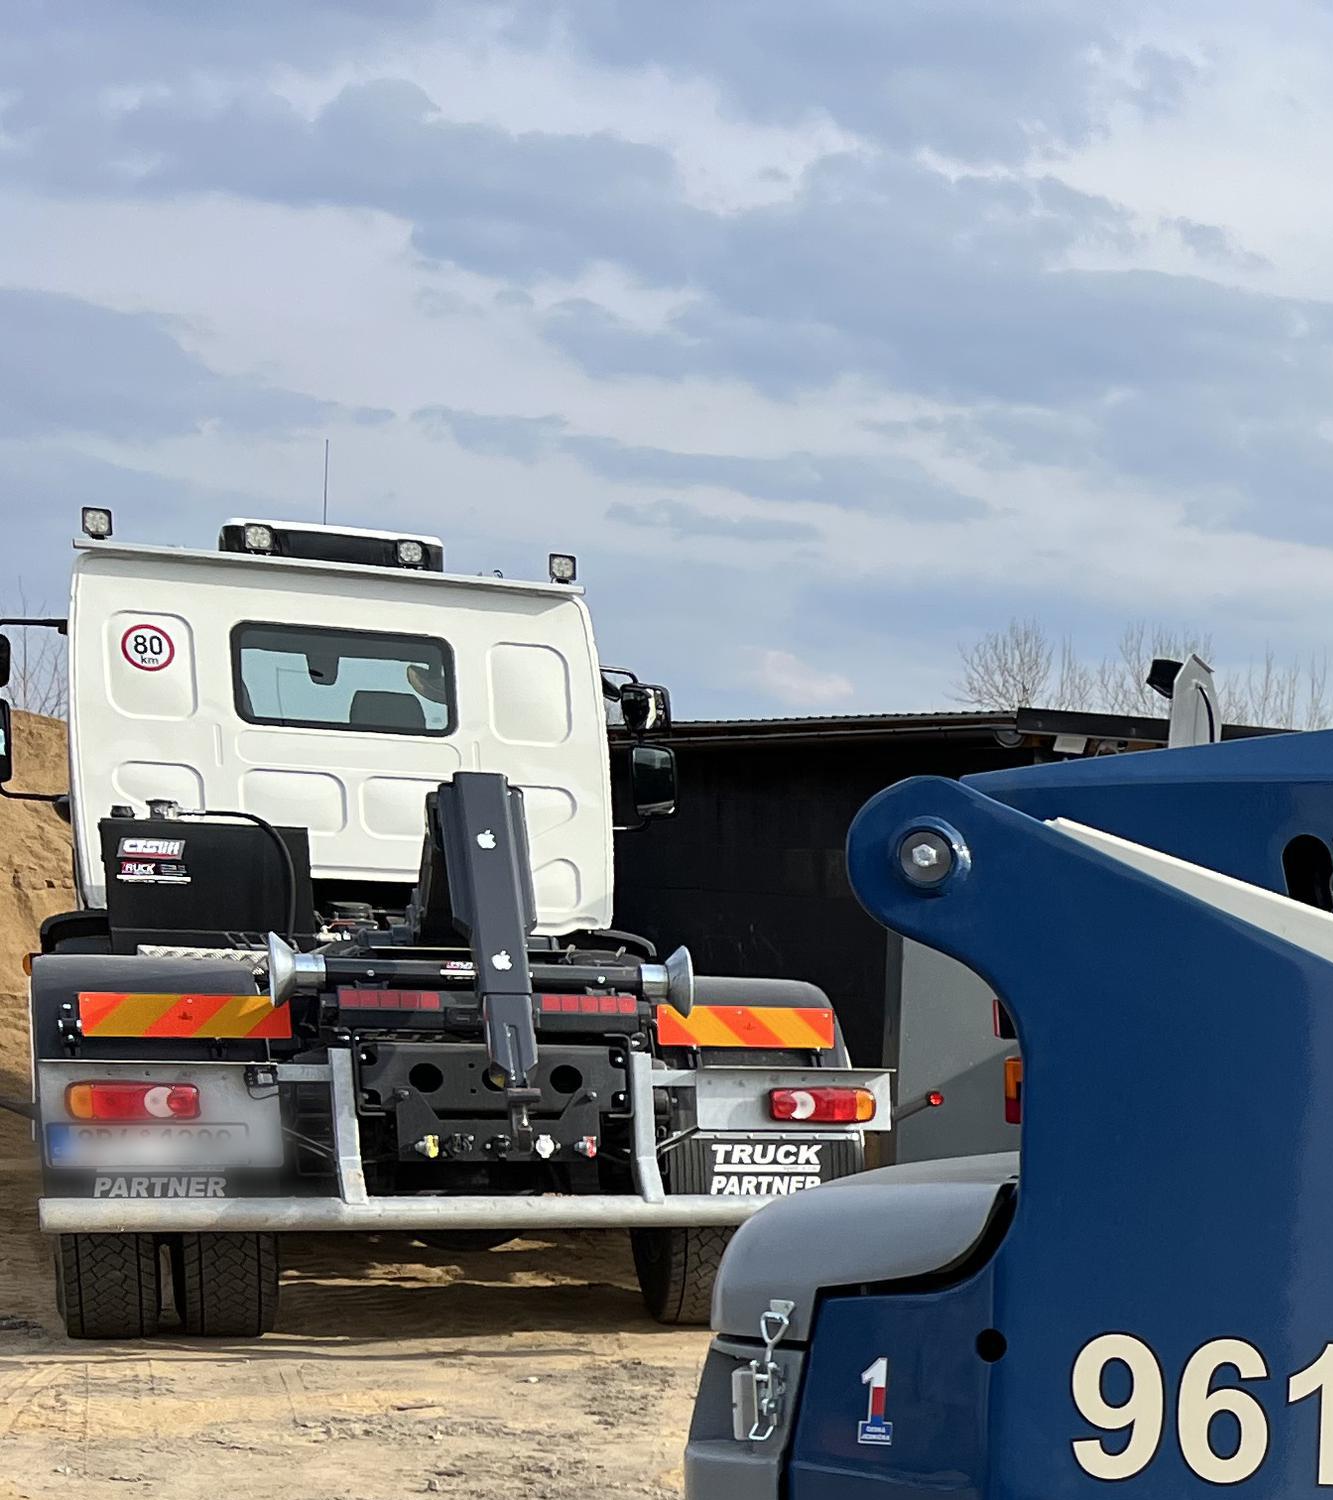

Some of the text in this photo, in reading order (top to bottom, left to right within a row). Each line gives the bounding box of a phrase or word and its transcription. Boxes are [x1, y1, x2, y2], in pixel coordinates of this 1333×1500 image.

[134, 634, 162, 655] 80
[141, 655, 159, 665] km
[711, 1143, 822, 1165] TRUCK
[93, 1176, 227, 1198] PARTNER
[710, 1175, 822, 1196] PARTNER
